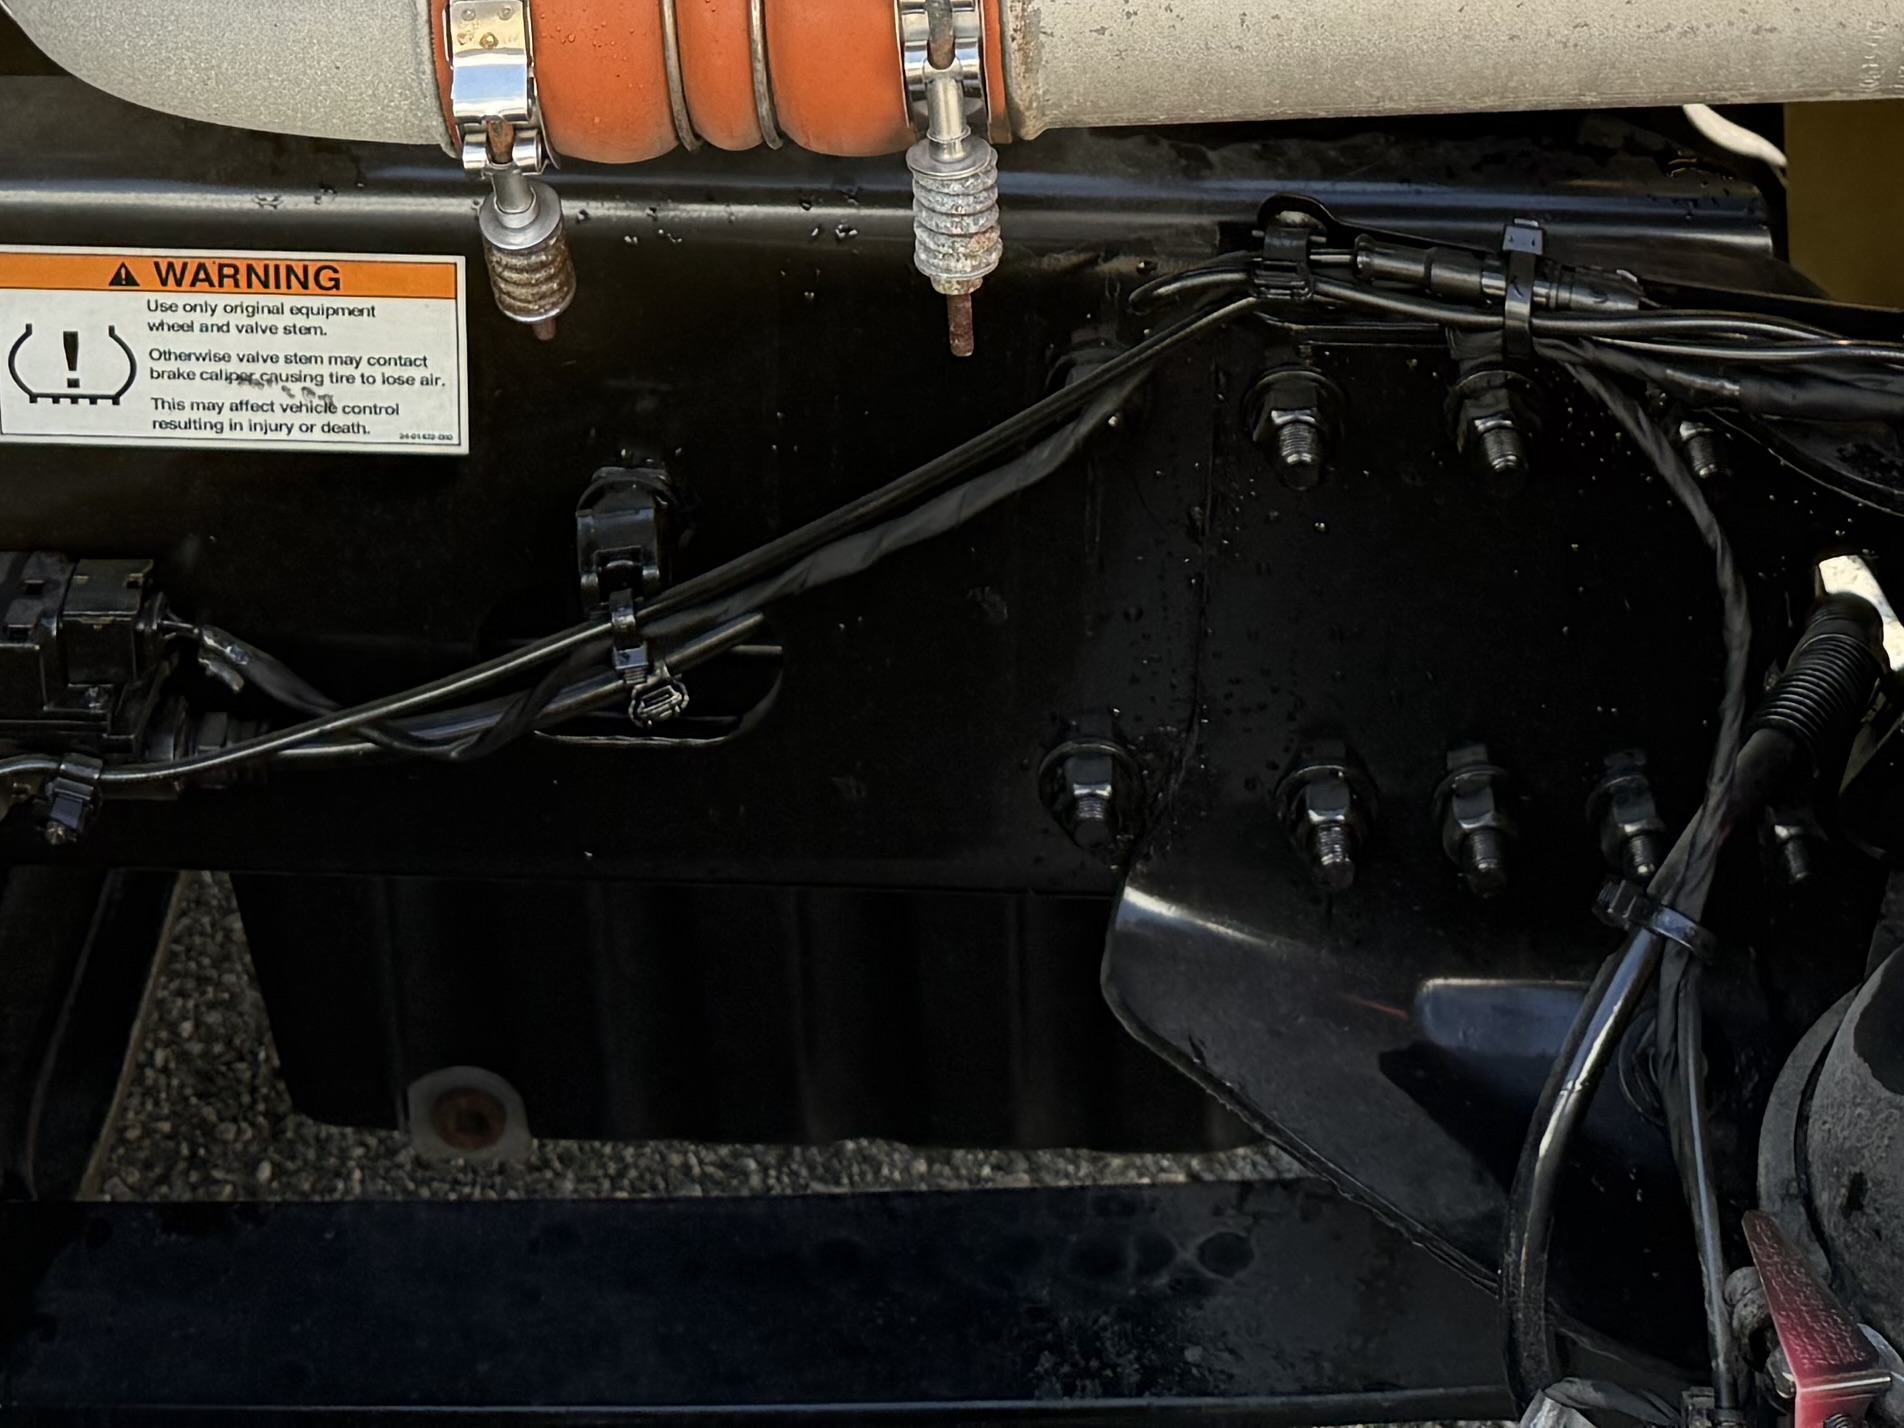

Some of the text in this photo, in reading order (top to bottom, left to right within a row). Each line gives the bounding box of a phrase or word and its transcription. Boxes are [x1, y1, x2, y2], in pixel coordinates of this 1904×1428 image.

[153, 261, 342, 291] WARNING
[147, 299, 376, 319] Use only original equipment
[147, 320, 328, 336] wheel and valve stem.
[149, 348, 428, 369] Otherwise valve stem may contact
[149, 367, 446, 388] brake caliper causing tire to lose air.
[151, 396, 400, 416] This may affect vehicle control
[152, 417, 371, 436] resulting in injury or death.
